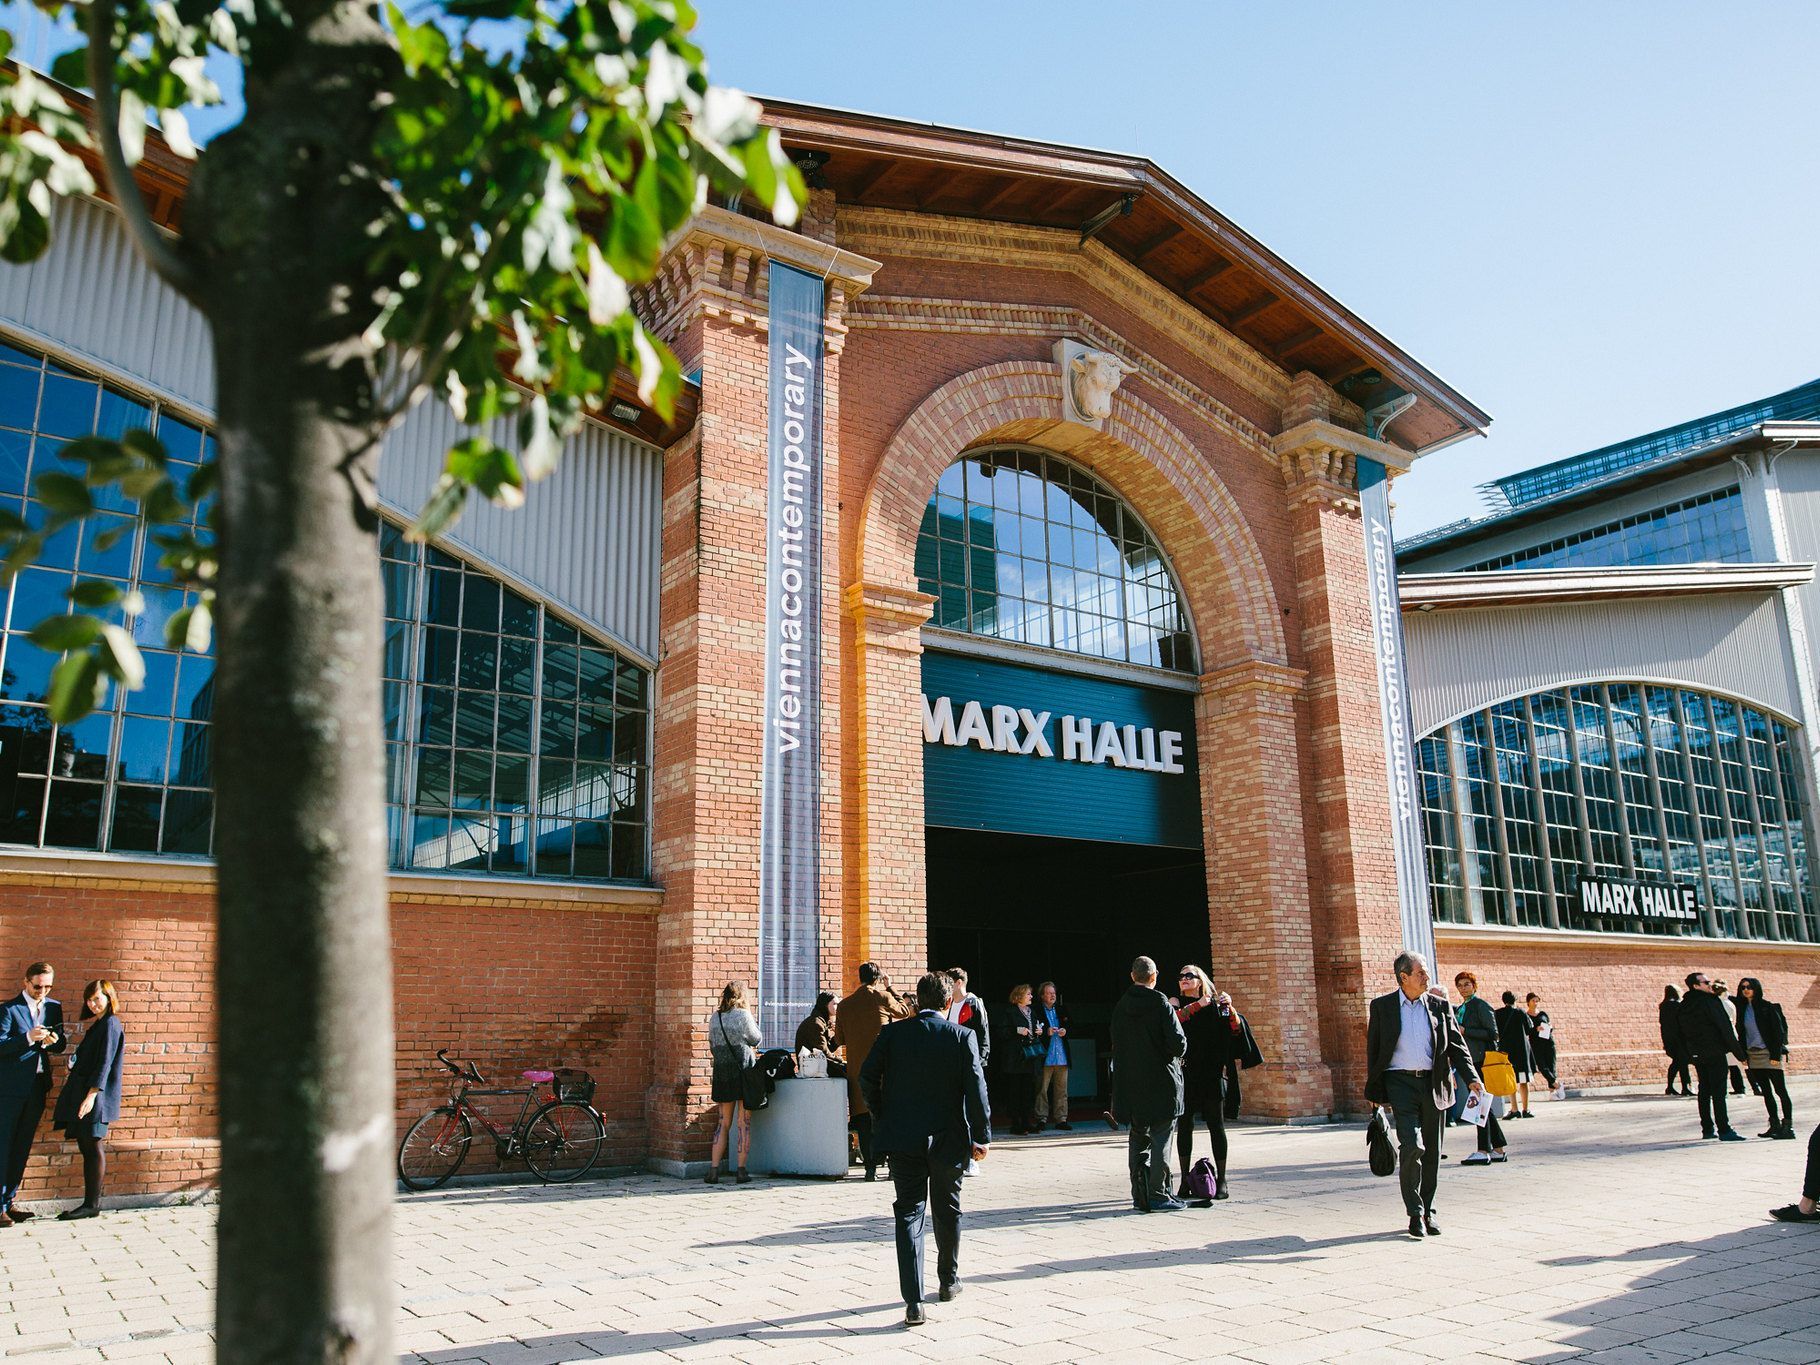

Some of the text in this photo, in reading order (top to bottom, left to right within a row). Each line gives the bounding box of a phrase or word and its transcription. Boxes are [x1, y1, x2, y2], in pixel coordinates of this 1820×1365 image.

[773, 342, 812, 754] viennacontemporary
[921, 693, 1184, 774] MARX HALLE
[1371, 517, 1411, 821] viennacontemporary
[1581, 881, 1697, 919] MARX HALLE
